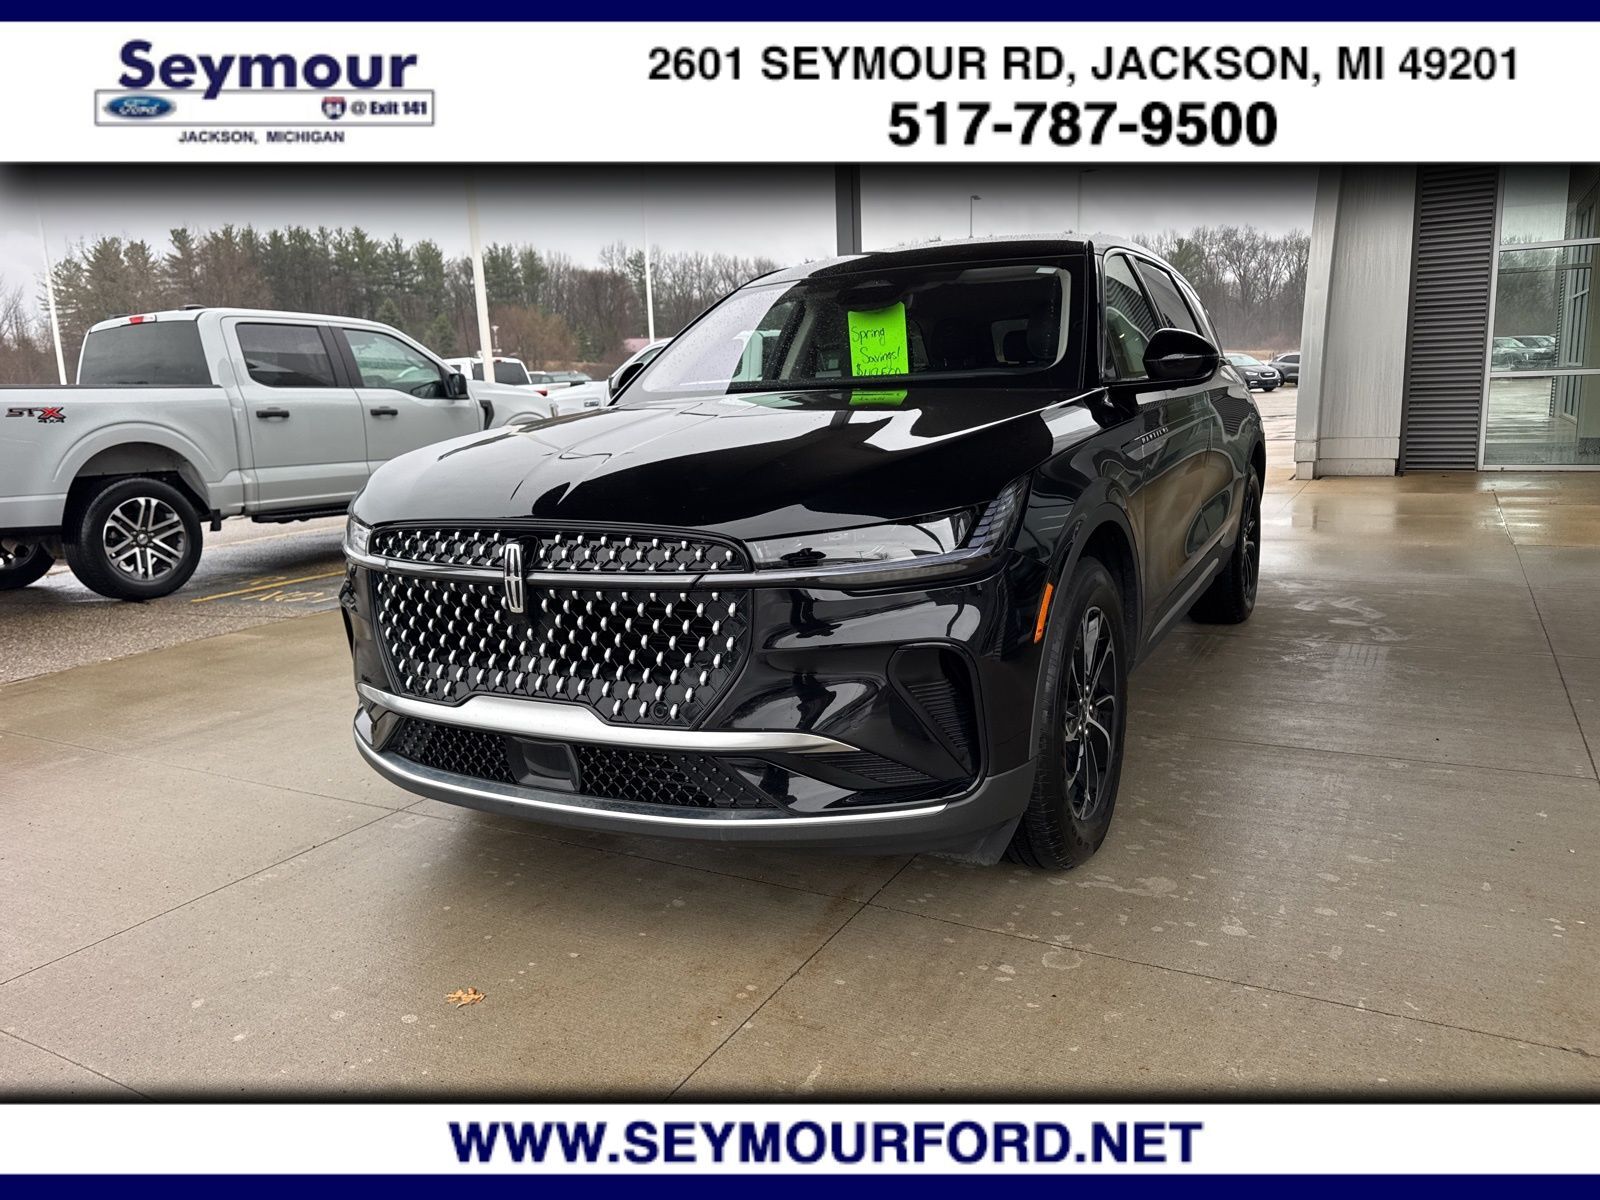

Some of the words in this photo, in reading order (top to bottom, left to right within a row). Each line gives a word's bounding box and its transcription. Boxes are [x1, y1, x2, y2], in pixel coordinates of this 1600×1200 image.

[851, 326, 886, 347] Spring
[860, 346, 901, 369] Savings!
[5, 407, 66, 419] STX
